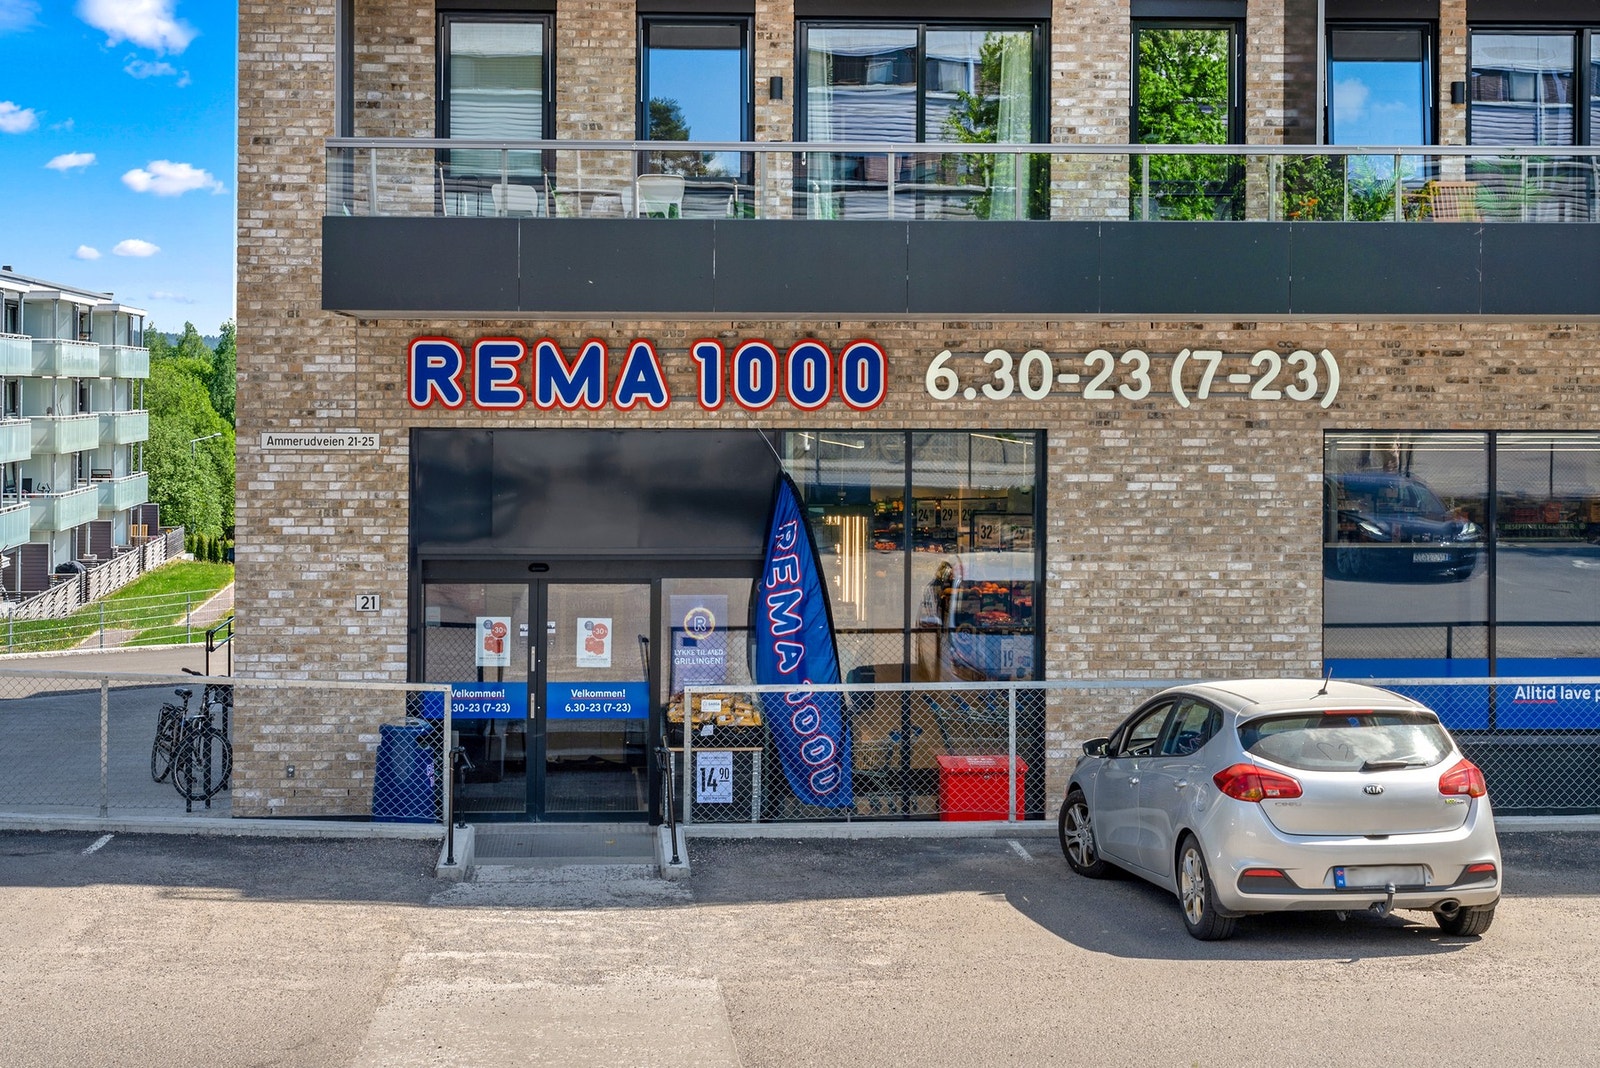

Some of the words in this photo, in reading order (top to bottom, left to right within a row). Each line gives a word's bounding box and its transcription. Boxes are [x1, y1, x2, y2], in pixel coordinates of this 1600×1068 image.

[408, 336, 671, 411] REMA
[690, 338, 888, 412] 1000
[925, 349, 1152, 400] 6.30-23
[1170, 348, 1340, 408] (7-23)
[266, 435, 345, 447] Ammerudveien
[347, 436, 375, 447] 21-25
[942, 508, 953, 521] 29
[980, 525, 993, 540] 32
[360, 596, 376, 610] 21
[766, 519, 806, 675] REMA
[694, 616, 706, 632] R
[674, 657, 724, 665] GRILLINGEN!
[451, 689, 505, 698] Velkommen!
[571, 689, 626, 698] Velkommen!
[1514, 685, 1556, 700] Alltid
[1560, 685, 1591, 700] lave
[451, 703, 480, 713] .30-23
[482, 703, 511, 713] (7-23)
[565, 703, 601, 712] 6.30-23
[603, 703, 632, 713] (7-23)
[785, 678, 843, 796] 1000
[700, 767, 718, 792] 14
[719, 767, 730, 779] 90
[1366, 786, 1383, 794] KIA
